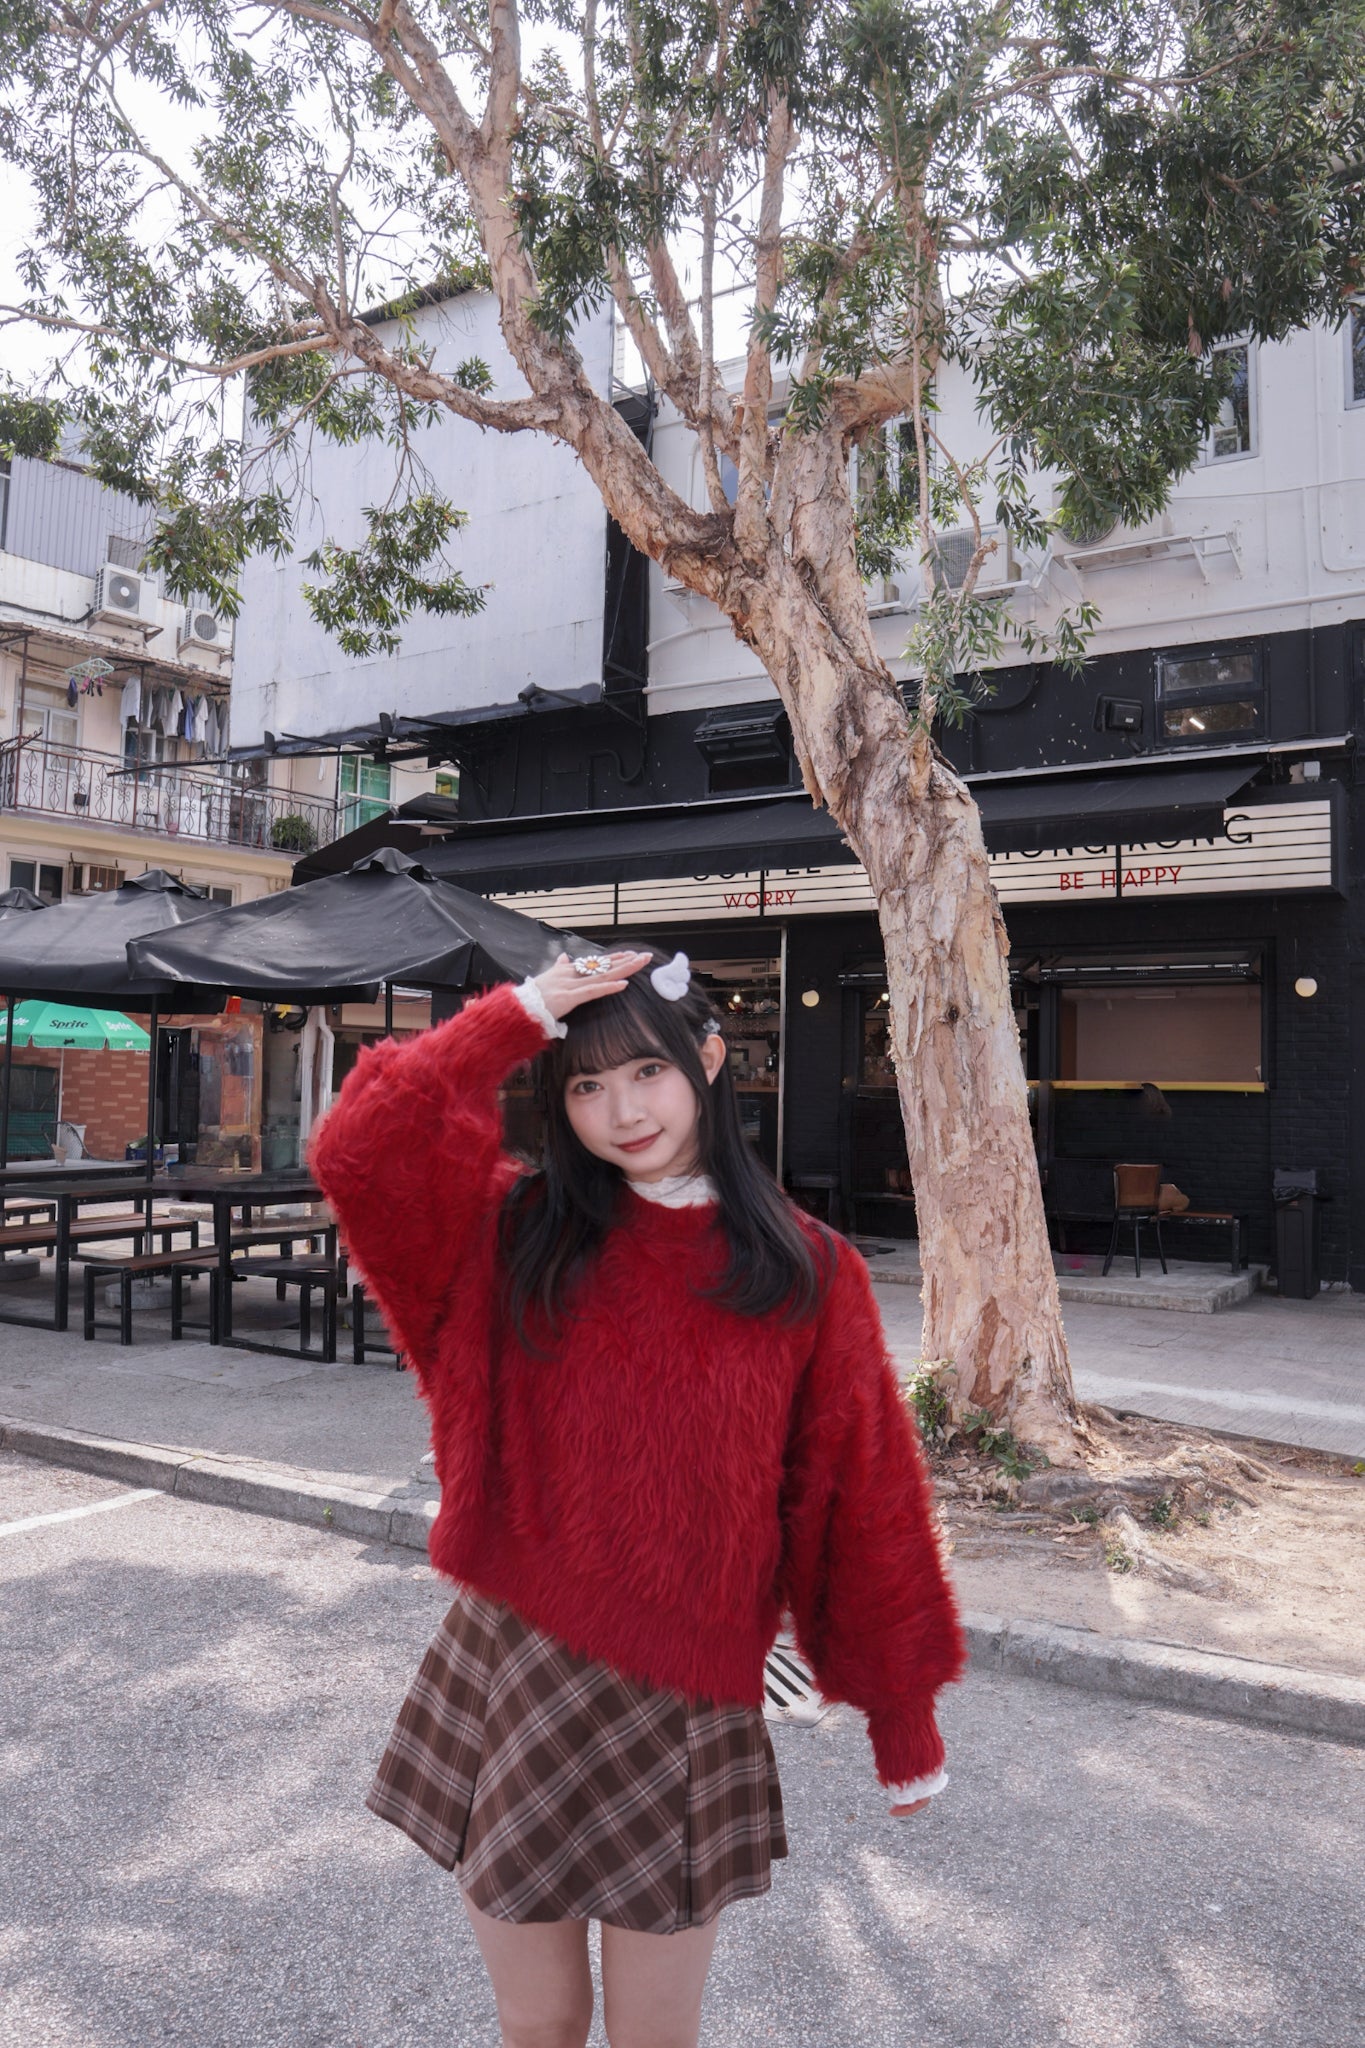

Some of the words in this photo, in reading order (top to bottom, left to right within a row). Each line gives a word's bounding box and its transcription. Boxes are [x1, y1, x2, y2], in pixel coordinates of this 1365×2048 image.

[724, 890, 796, 909] WORRY
[1060, 872, 1084, 891] BE
[1101, 867, 1181, 889] HAPPY
[49, 1019, 88, 1029] Sprite
